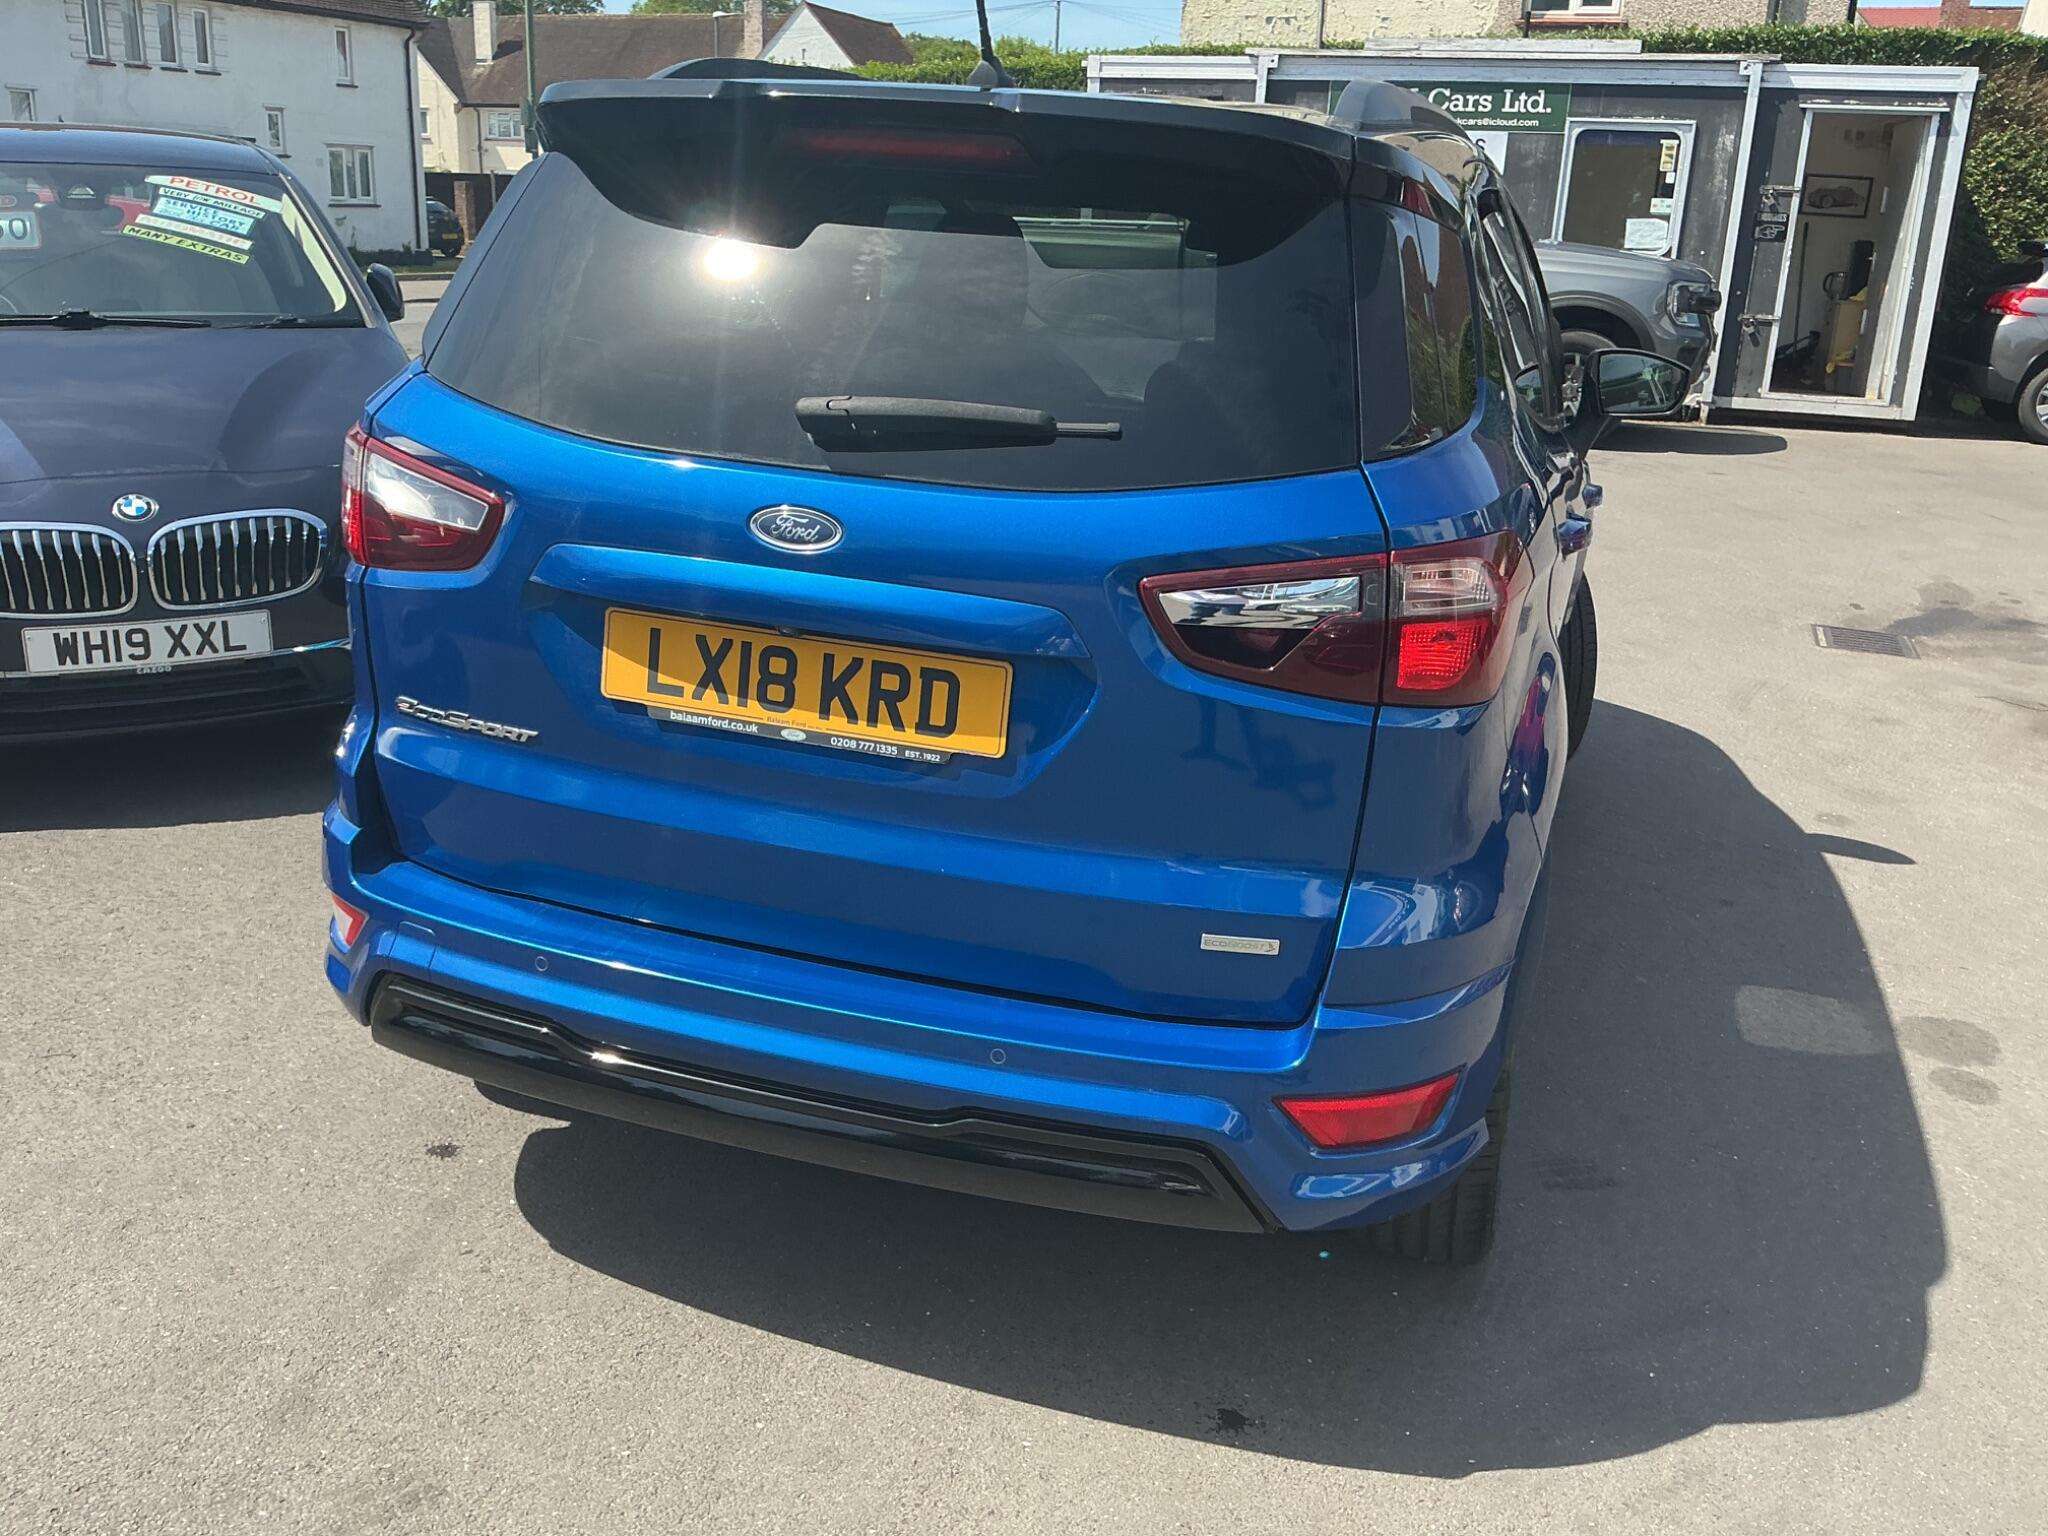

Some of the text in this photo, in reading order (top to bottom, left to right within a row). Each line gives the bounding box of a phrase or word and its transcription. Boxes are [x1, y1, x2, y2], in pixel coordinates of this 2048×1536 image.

[1428, 87, 1552, 114] Cars Ltd.
[1456, 117, 1540, 127] kcars@icloud.com
[163, 188, 190, 198] VERY
[212, 199, 262, 217] MILEAGE
[169, 176, 258, 204] PETROL
[127, 226, 171, 242] MANY
[176, 239, 244, 262] EXTRAS
[769, 514, 821, 542] Ford
[53, 619, 249, 667] WH19 XXL
[646, 627, 961, 739] LX18 KRD
[669, 710, 759, 734] balaamford.co.uk
[830, 736, 898, 756] 0208 777 1335
[904, 750, 941, 762] EST. 1922
